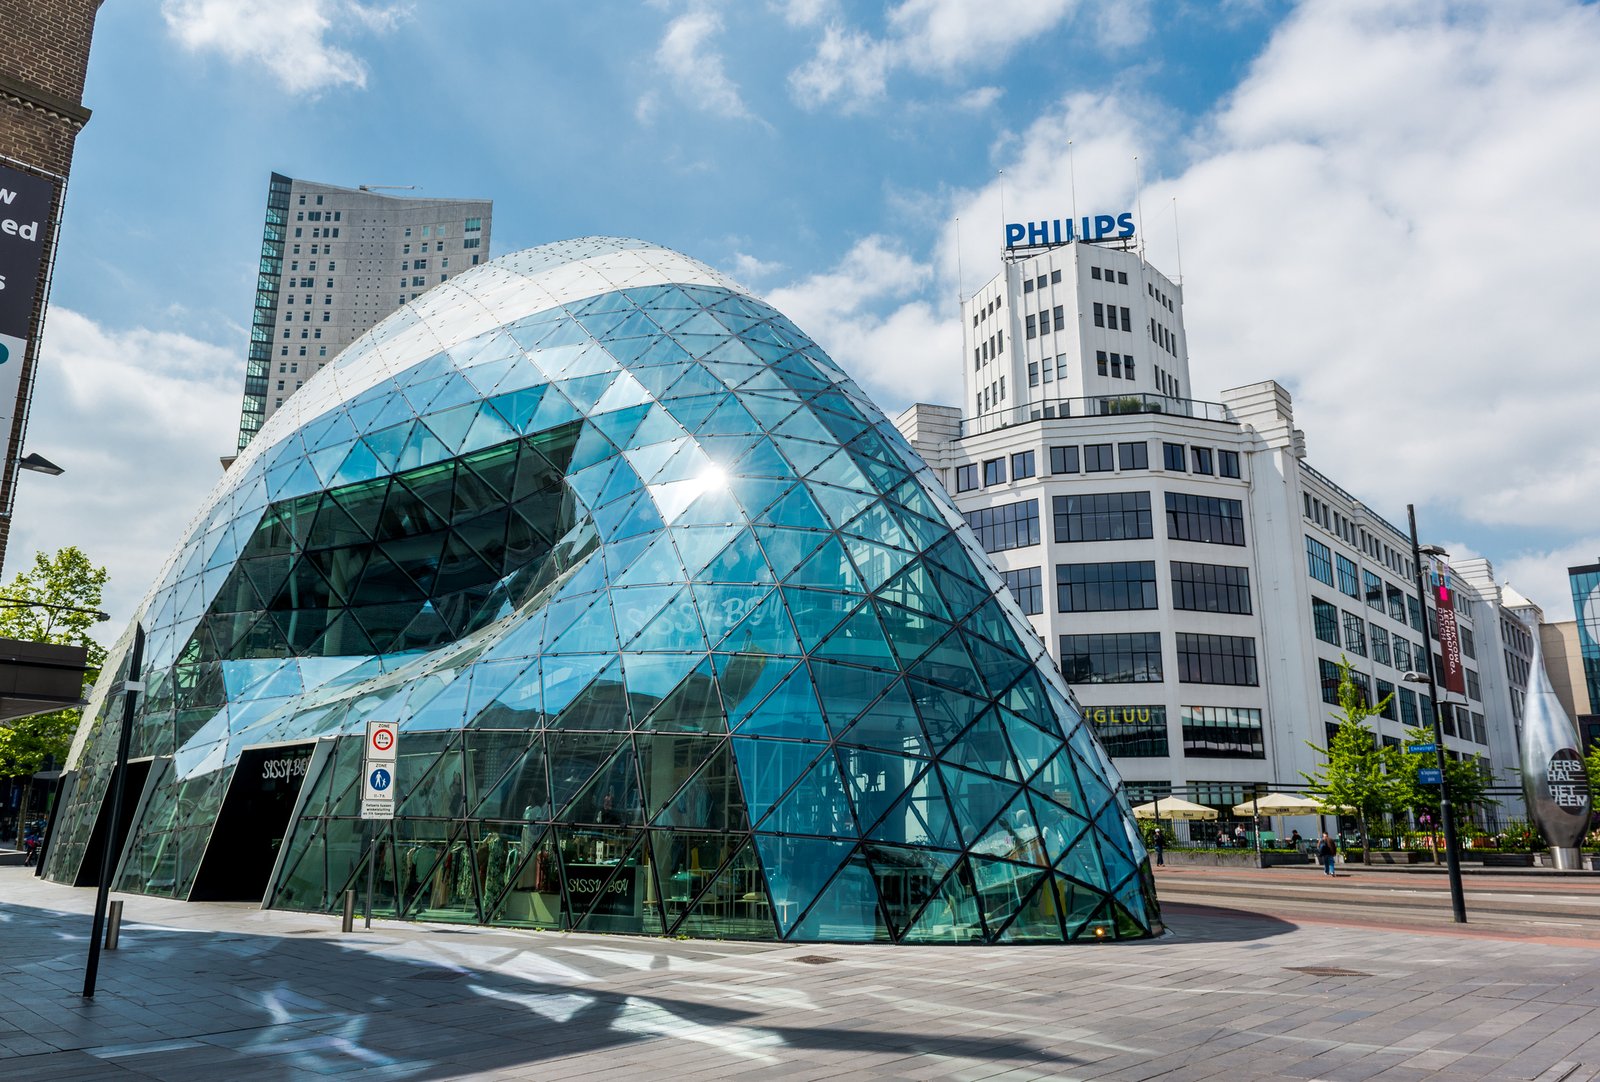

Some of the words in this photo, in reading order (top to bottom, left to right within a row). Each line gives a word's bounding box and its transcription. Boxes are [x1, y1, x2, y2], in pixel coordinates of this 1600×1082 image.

[1, 218, 39, 242] ed
[1005, 212, 1136, 248] PHILIPS
[1085, 708, 1150, 723] IGLUU
[1547, 770, 1575, 781] HAL
[1548, 784, 1576, 796] HET
